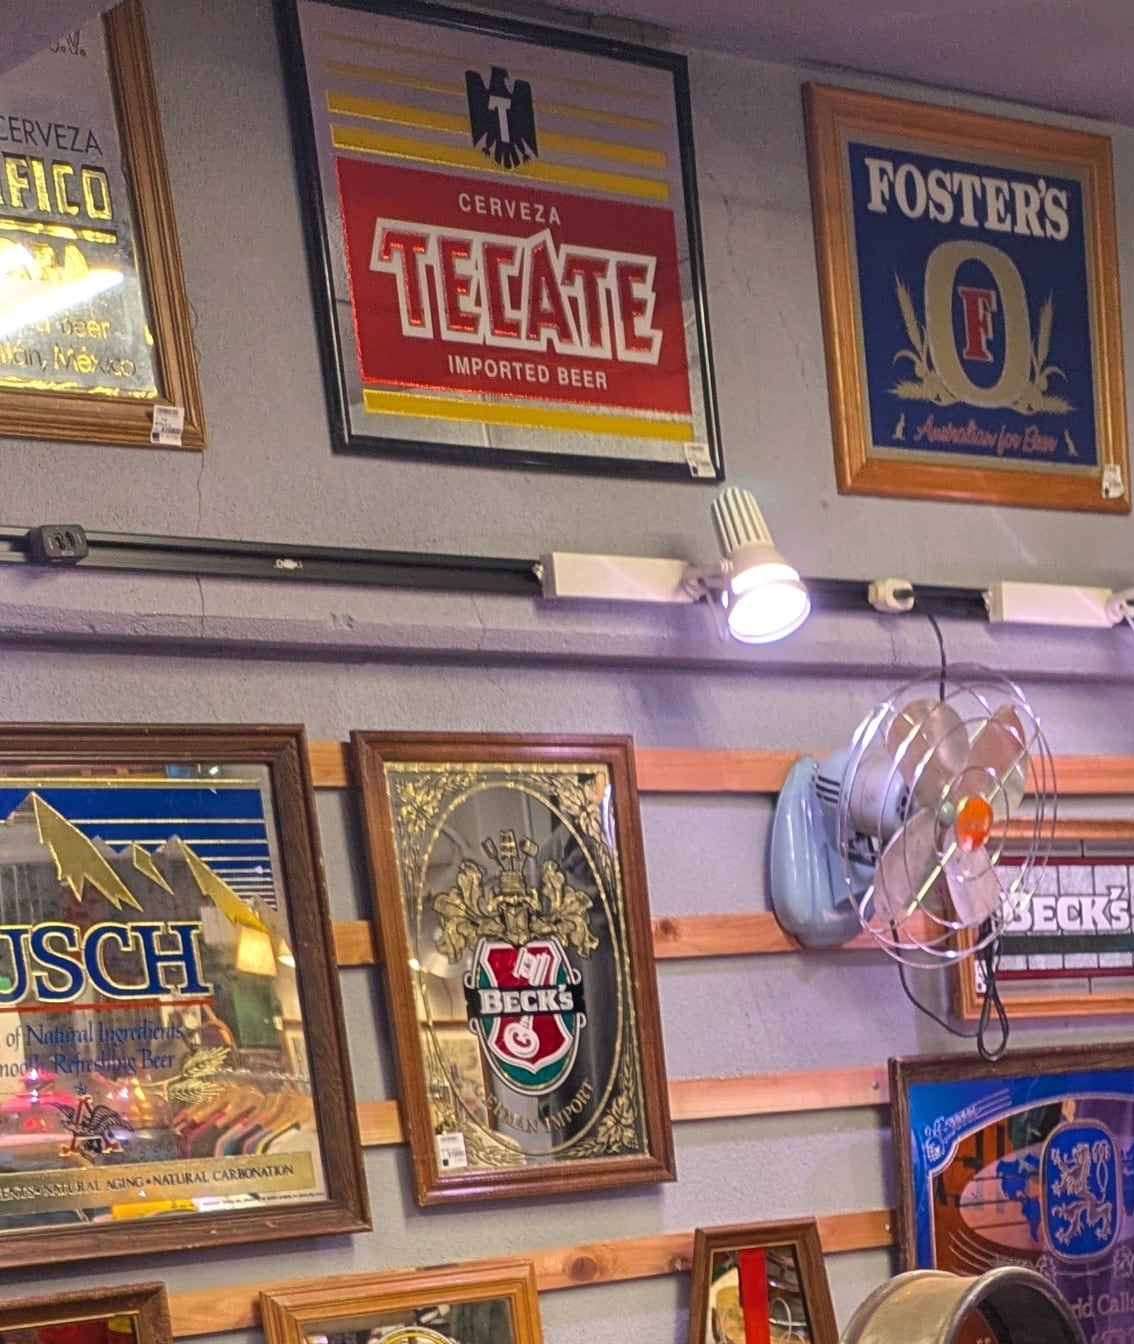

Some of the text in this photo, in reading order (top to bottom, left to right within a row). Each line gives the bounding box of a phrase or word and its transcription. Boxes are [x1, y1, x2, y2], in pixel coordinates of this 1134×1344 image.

[487, 95, 512, 143] T
[0, 151, 114, 221] FICO
[457, 192, 562, 226] CERVEZA
[864, 156, 1070, 242] FOSTER'S
[369, 217, 664, 366] TECATE
[957, 285, 999, 363] F
[447, 354, 609, 391] IMPORTED BEER
[25, 1021, 94, 1049] Natural
[138, 1046, 176, 1070] Beer
[543, 1078, 595, 1133] IMPORT
[42, 1178, 103, 1198] NATURAL
[105, 1175, 145, 1192] AGING
[152, 1168, 209, 1187] NATURAL
[212, 1163, 295, 1182] CARBONATION
